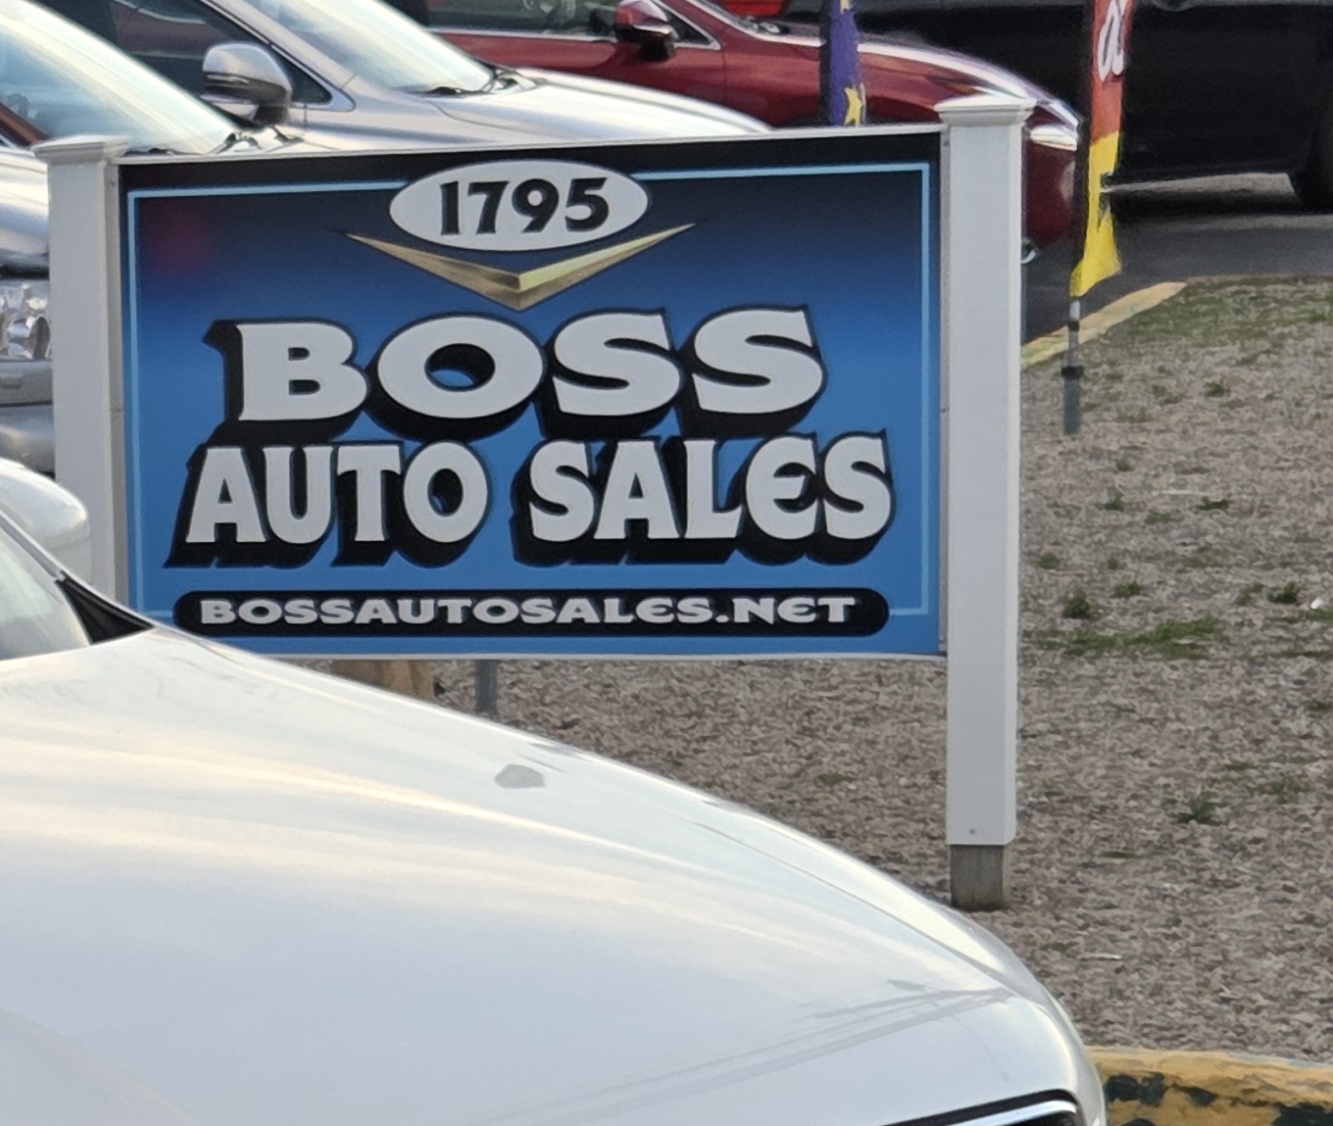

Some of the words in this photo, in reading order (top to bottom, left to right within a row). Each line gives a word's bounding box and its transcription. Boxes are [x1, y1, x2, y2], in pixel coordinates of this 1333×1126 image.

[438, 177, 611, 236] 1795
[234, 308, 828, 421] BOSS
[184, 440, 489, 546] AUTO
[529, 432, 894, 544] SALES
[198, 595, 858, 627] BOSSAUTOSALES.NET
